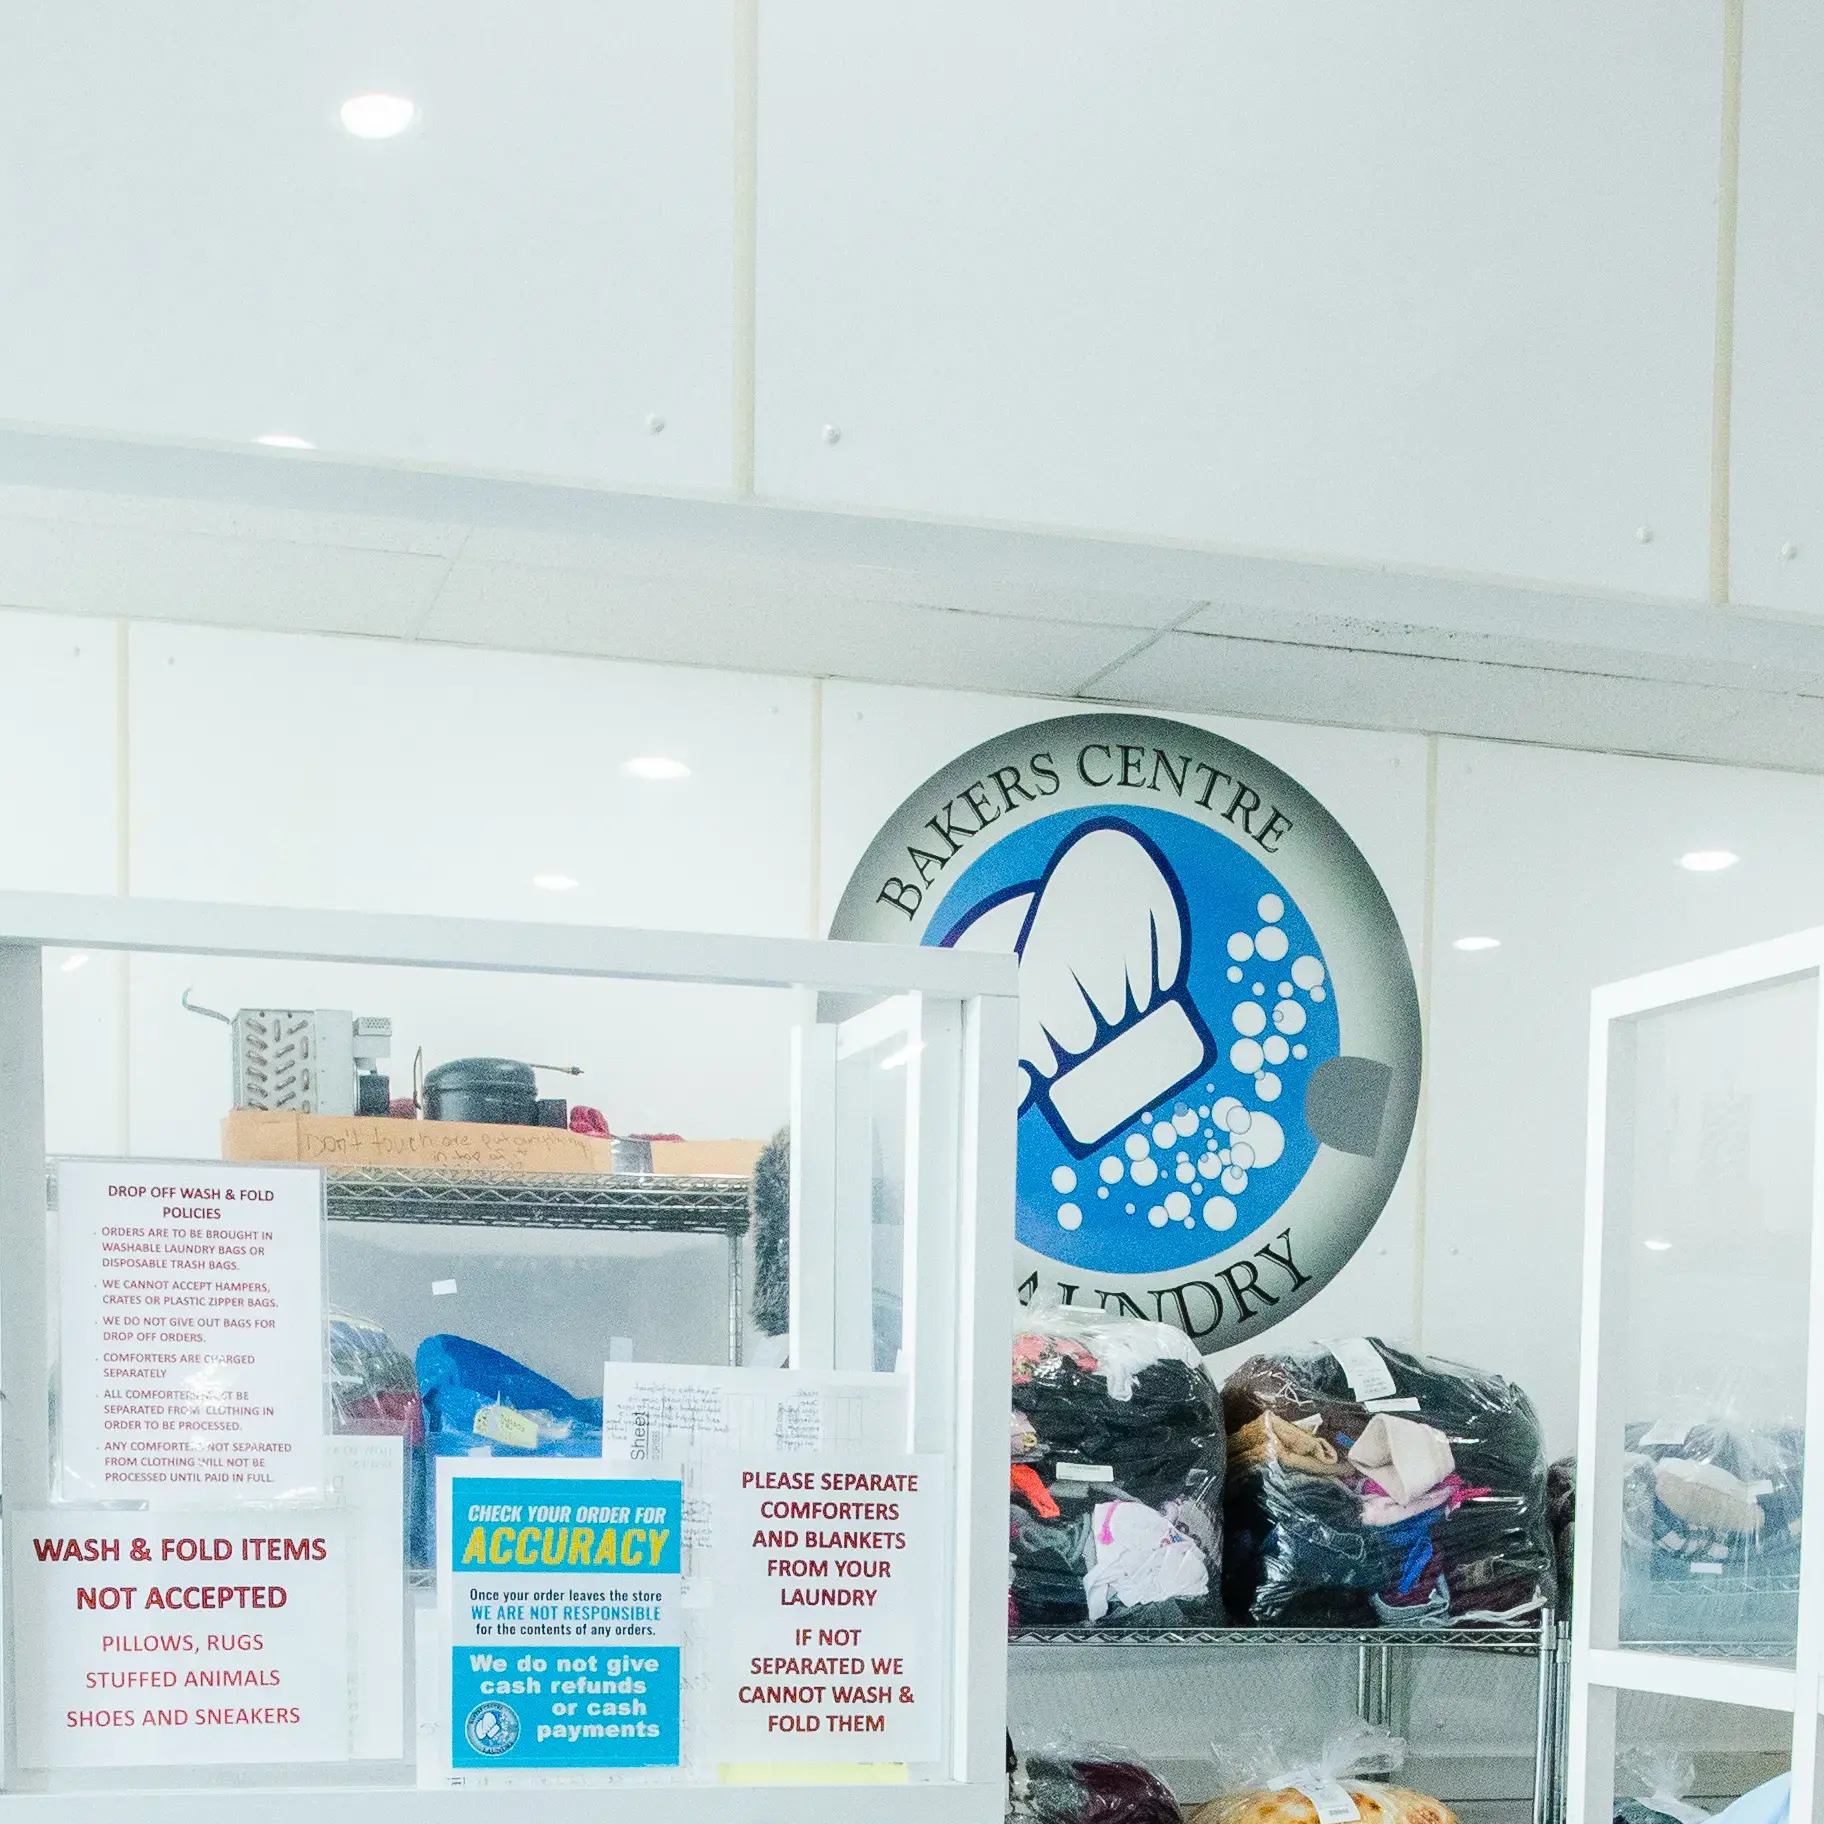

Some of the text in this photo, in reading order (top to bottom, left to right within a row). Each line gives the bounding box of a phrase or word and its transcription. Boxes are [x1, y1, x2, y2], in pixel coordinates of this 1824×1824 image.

[876, 743, 1294, 921] BAKERS CENTRE
[109, 1186, 274, 1202] DROP OFF WASH & FOLD
[163, 1207, 221, 1219] POLICIES
[102, 1227, 273, 1240] ORDERS ARE TO BE BROUGHT IN
[102, 1243, 264, 1255] WASHABLE LAUNDRY BAGS OR
[103, 1258, 239, 1270] DISPOSABLE TRASH BAGS.
[742, 1472, 918, 1492] PLEASE SEPARATE
[468, 1505, 666, 1524] CHECK YOUR ORDER FOR
[760, 1502, 899, 1520] COMFORTERS
[462, 1526, 670, 1566] ACCURACY
[752, 1531, 906, 1549] AND BLANKETS
[33, 1538, 327, 1561] WASH & FOLD ITEMS
[768, 1560, 890, 1578] FROM YOUR
[77, 1586, 287, 1609] NOT ACCEPTED
[470, 1588, 662, 1602] Once your order leaves the store
[782, 1589, 877, 1606] LAUNDRY
[102, 1634, 263, 1654] PILLOWS, RUGS
[796, 1629, 862, 1646] IF NOT
[750, 1658, 903, 1674] SEPARATED WE
[86, 1670, 280, 1689] STUFFED ANIMALS
[738, 1686, 914, 1704] CANNOT WASH &
[67, 1708, 300, 1728] SHOES AND SNEAKERS
[768, 1716, 884, 1732] FOLD THEM
